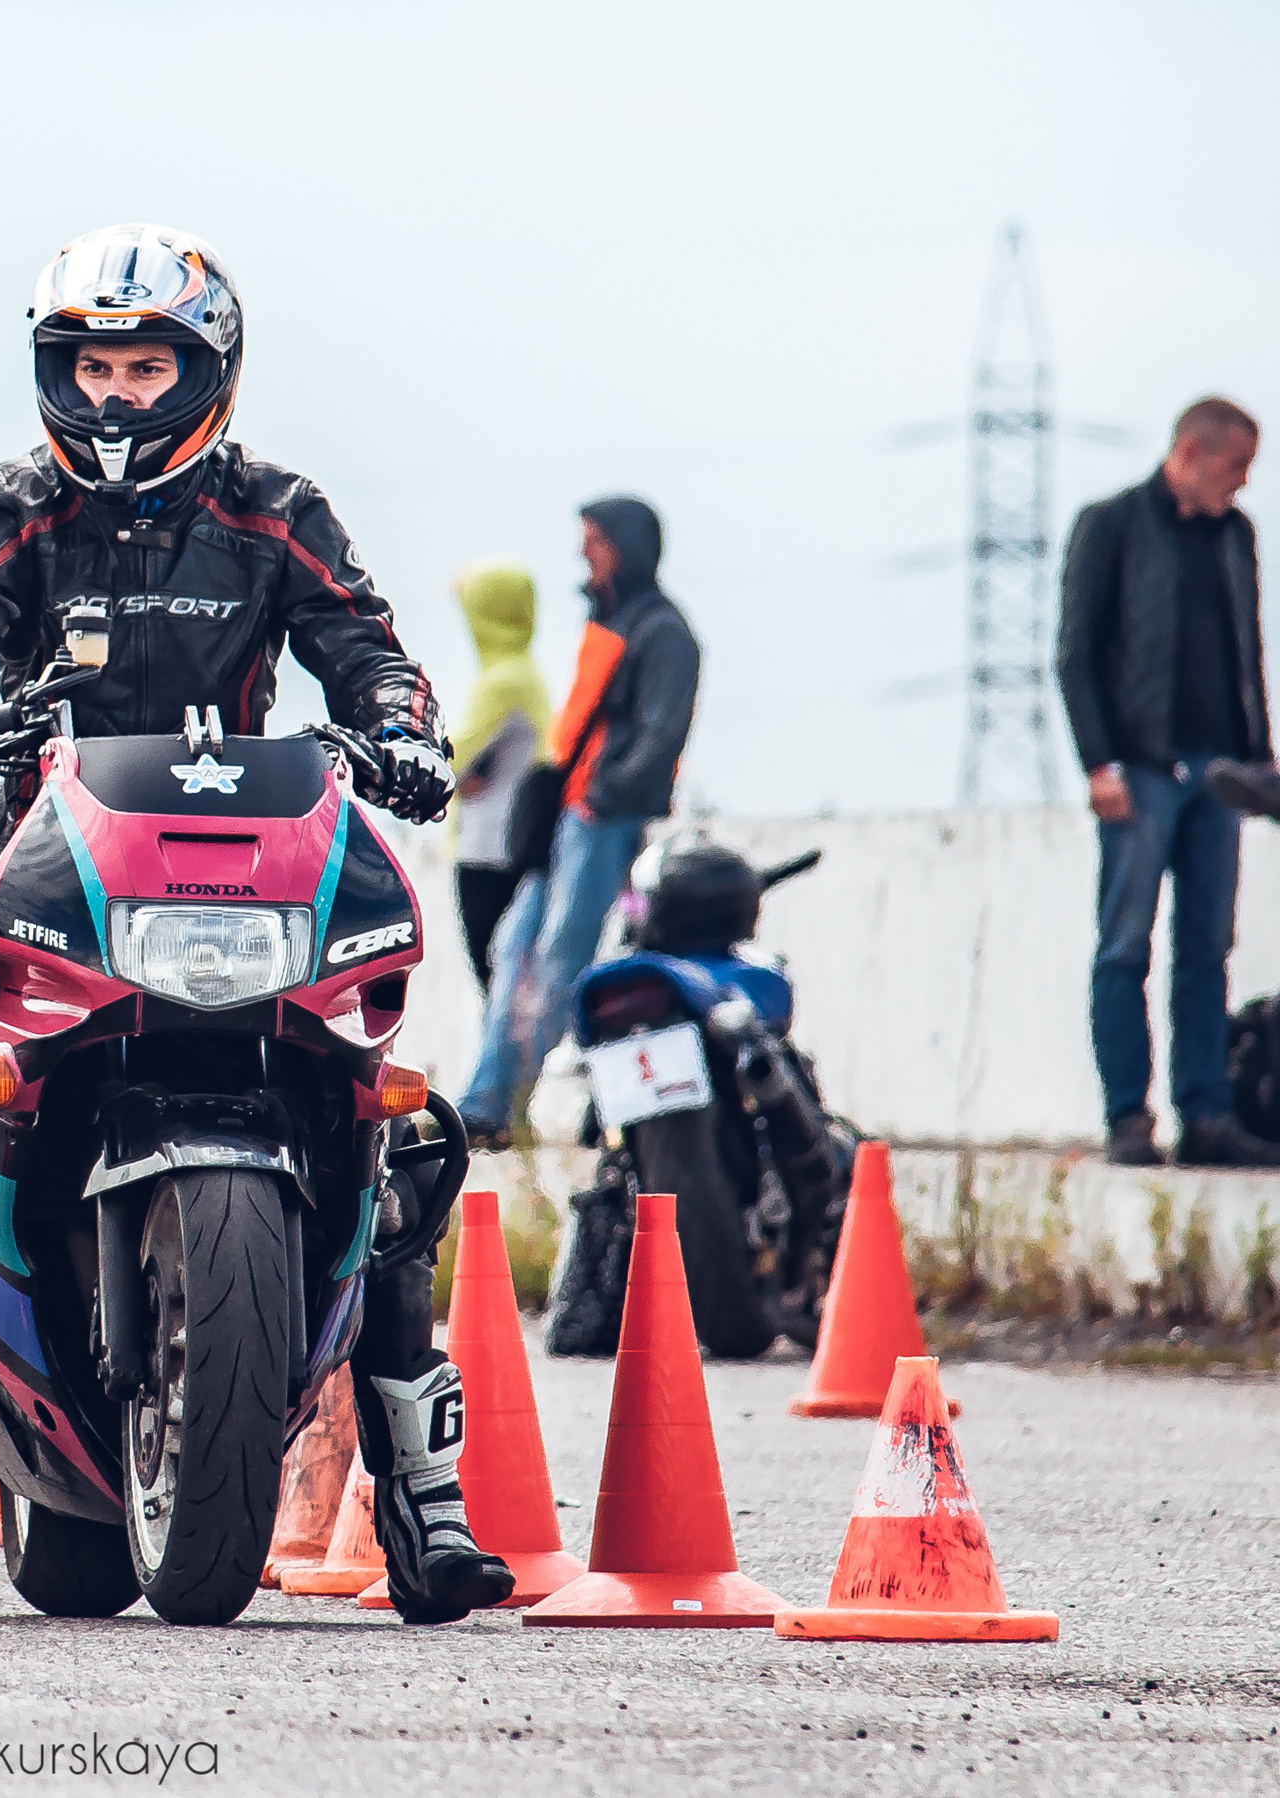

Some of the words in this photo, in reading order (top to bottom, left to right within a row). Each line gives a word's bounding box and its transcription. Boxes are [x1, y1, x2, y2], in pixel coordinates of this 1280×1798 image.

[164, 883, 259, 896] HONDA
[8, 918, 69, 951] JETFIRE
[327, 921, 414, 964] CBR
[427, 1389, 464, 1454] G
